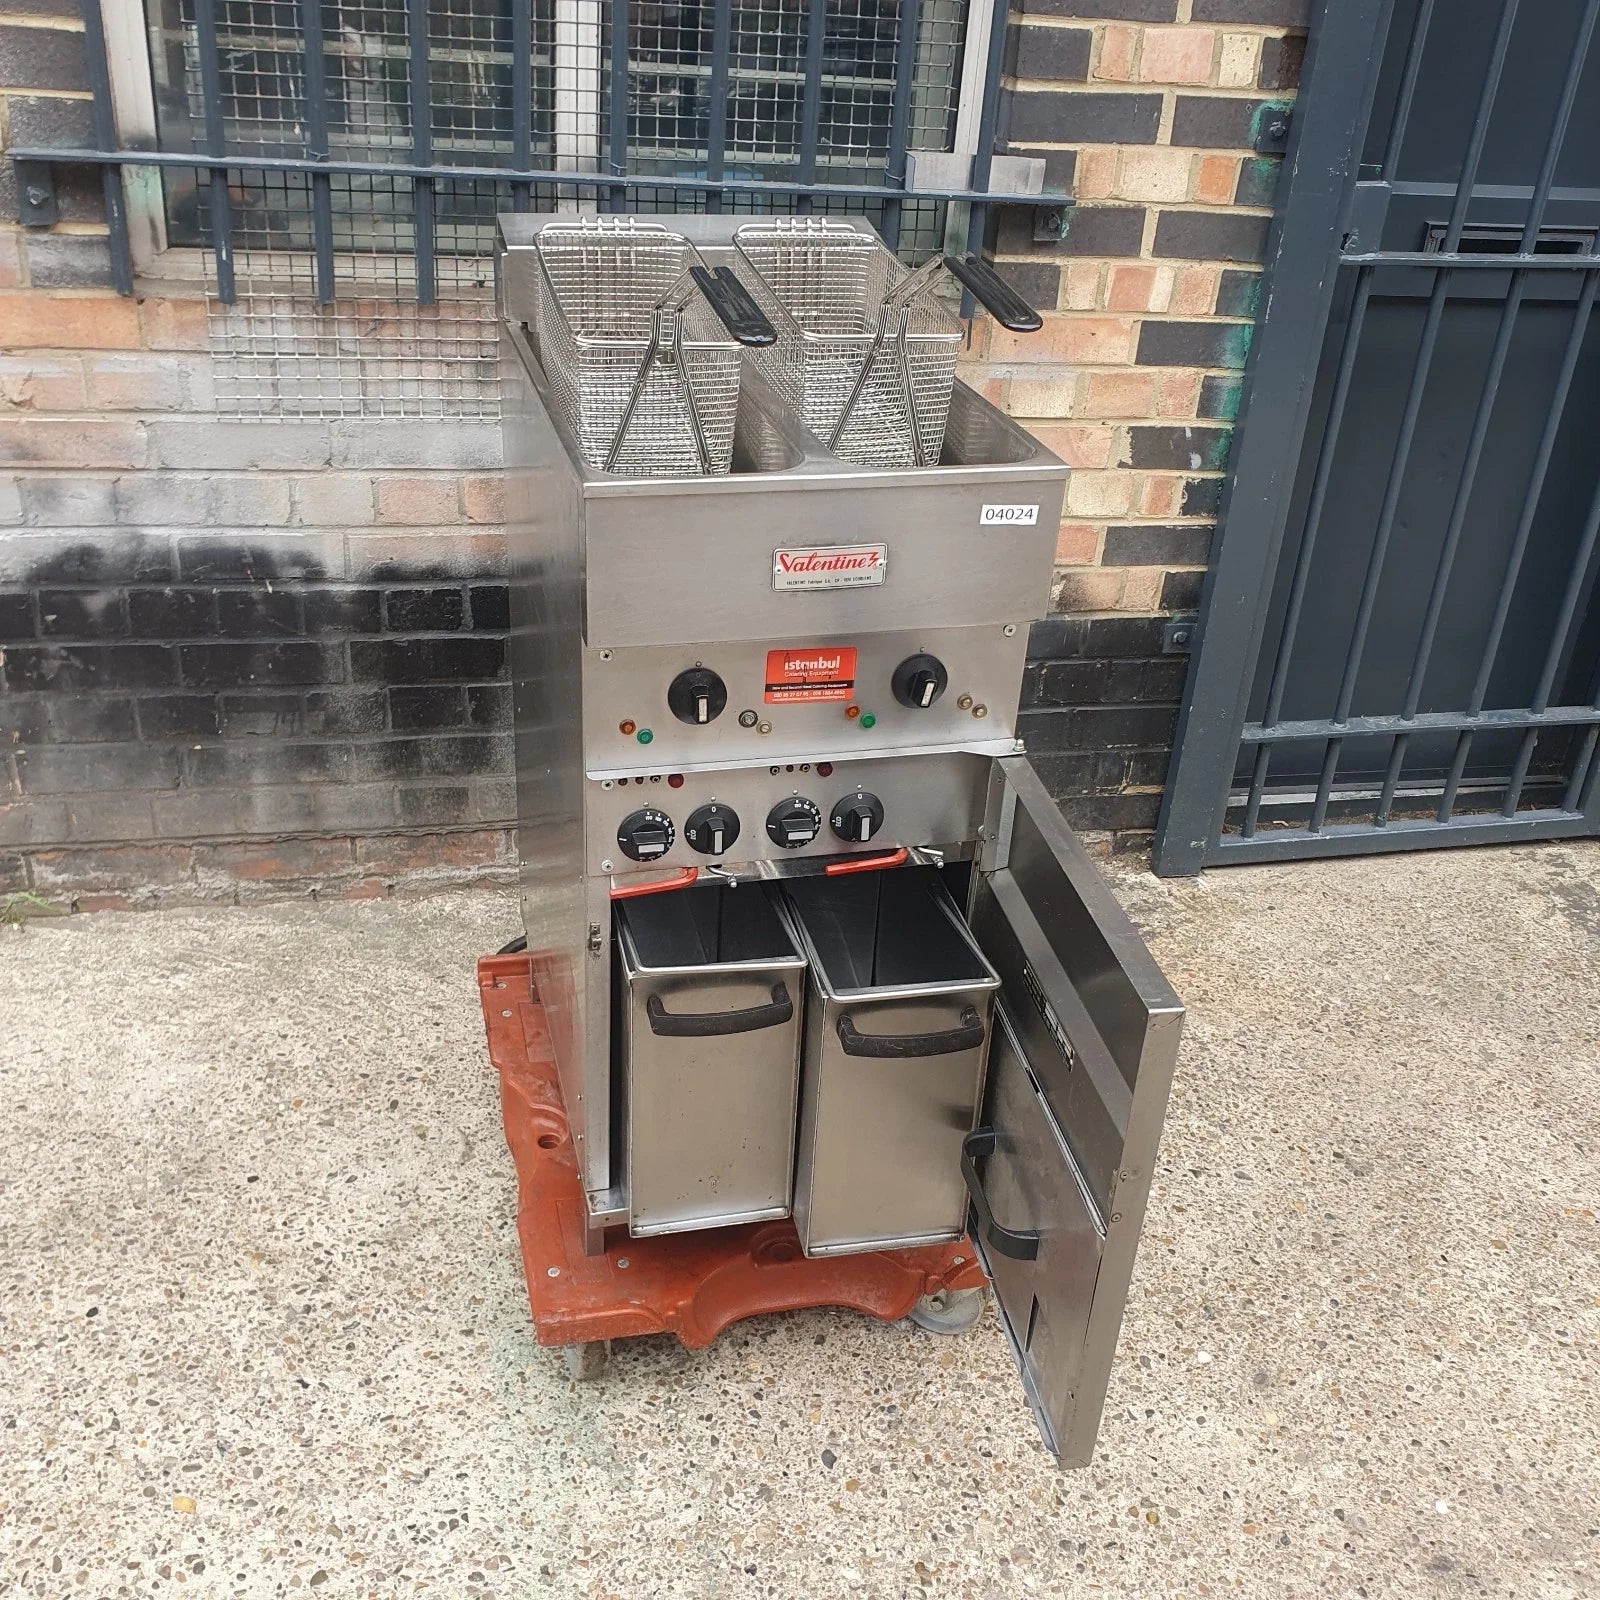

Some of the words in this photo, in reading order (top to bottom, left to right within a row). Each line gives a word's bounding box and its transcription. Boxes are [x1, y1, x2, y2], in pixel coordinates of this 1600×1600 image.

[986, 508, 1033, 520] 04024
[780, 552, 878, 573] Valentine
[785, 656, 840, 670] istanbul
